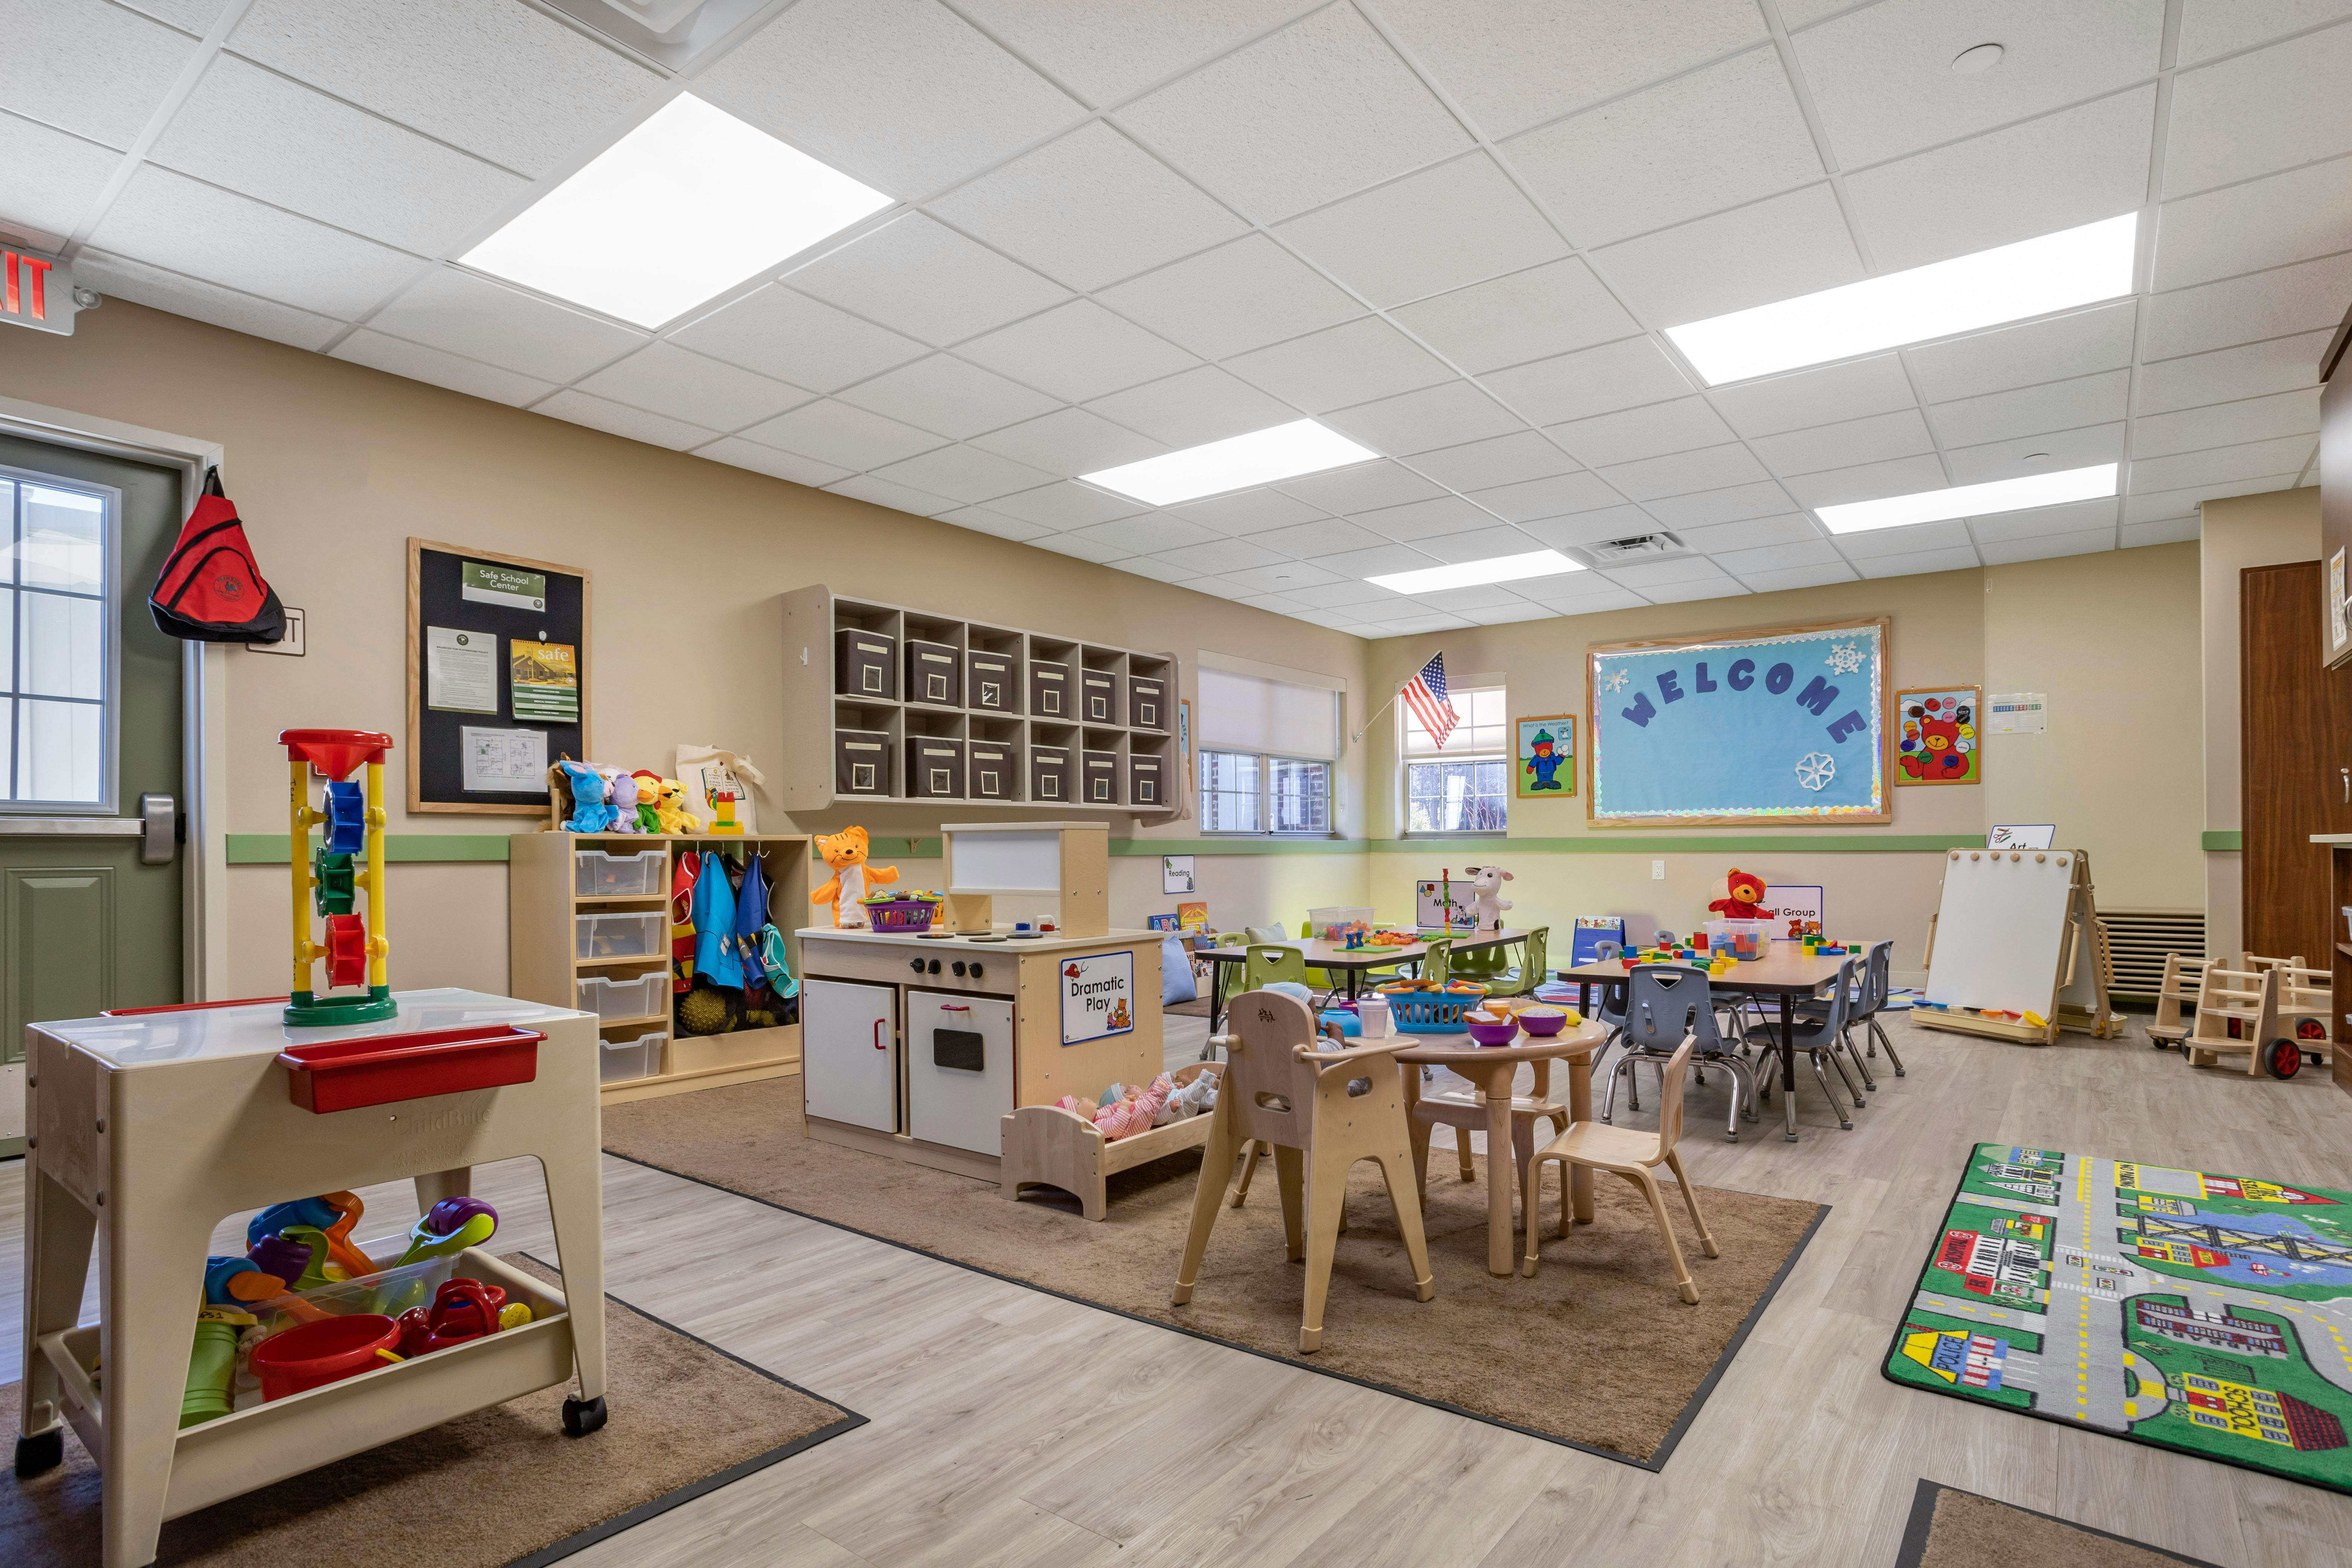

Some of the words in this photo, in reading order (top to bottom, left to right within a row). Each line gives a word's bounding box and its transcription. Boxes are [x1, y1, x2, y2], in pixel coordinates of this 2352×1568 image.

[480, 570, 498, 580] Safe
[501, 573, 529, 585] School
[490, 580, 519, 591] Center
[538, 647, 569, 662] safe
[1621, 658, 1867, 744] WELCOME
[1783, 908, 1815, 918] Group
[1154, 918, 1179, 933] ABC
[1071, 976, 1124, 997] Dramatic
[1086, 997, 1110, 1012] Play
[2241, 1180, 2263, 1200] STATION
[1943, 1237, 1968, 1264] HOSPITAL
[2156, 1328, 2270, 1355] LIBRARY
[1936, 1336, 1965, 1372] POLICE
[2223, 1386, 2258, 1431] SCHOOL
